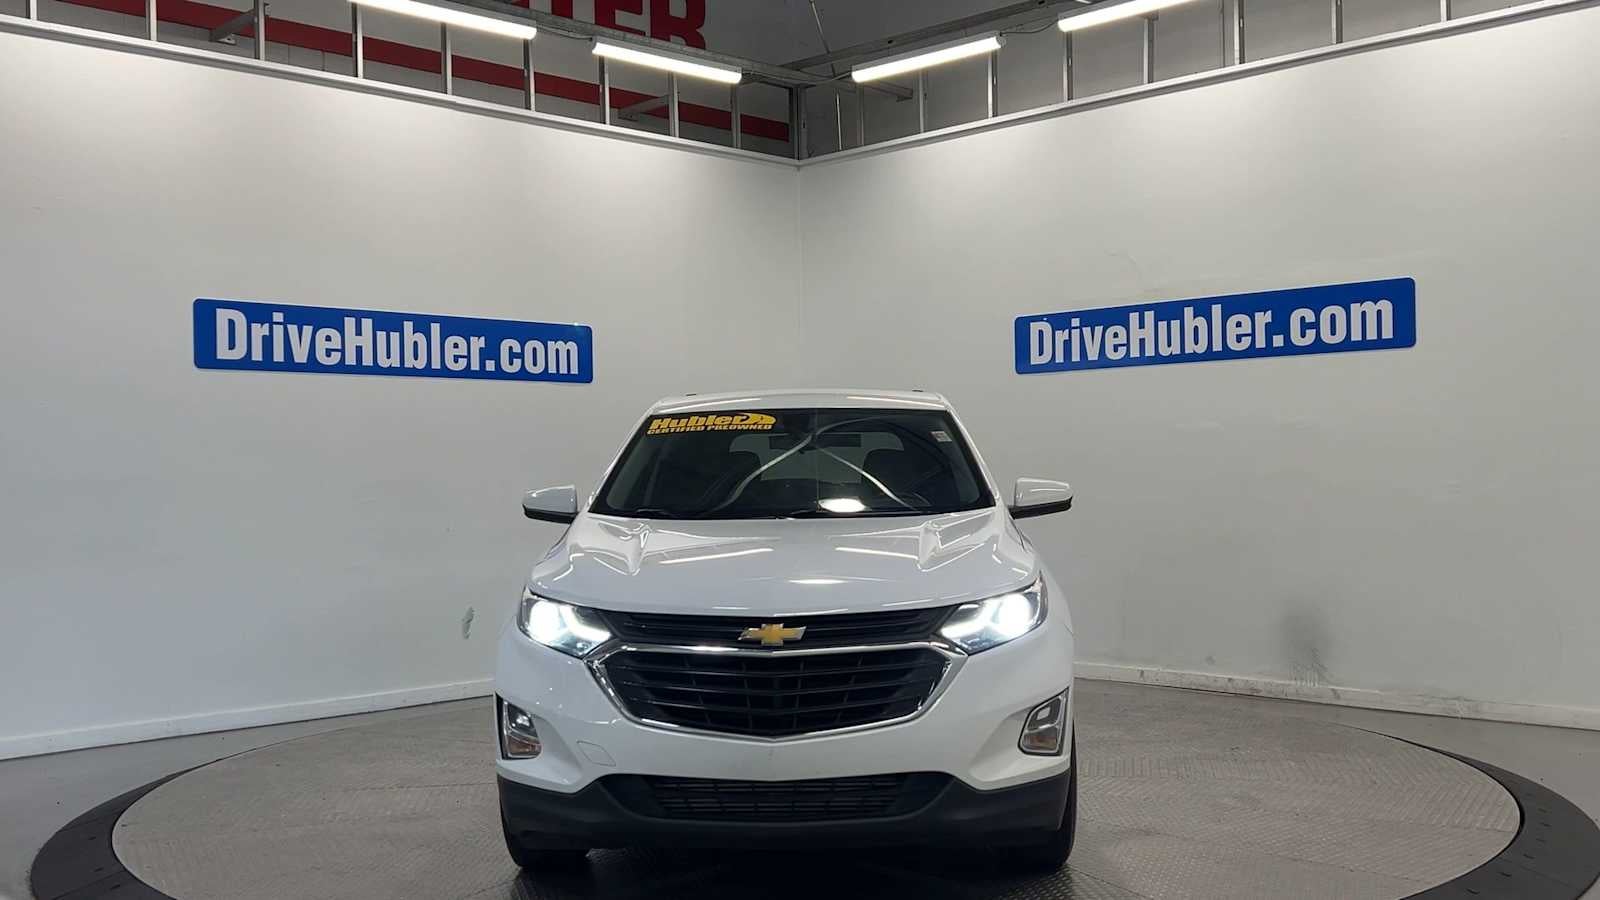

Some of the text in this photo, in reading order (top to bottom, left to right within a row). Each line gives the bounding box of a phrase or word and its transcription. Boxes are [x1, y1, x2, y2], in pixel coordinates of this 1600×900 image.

[216, 308, 579, 375] DriveHubler.com
[1030, 299, 1393, 365] DriveHubler.com
[647, 426, 704, 435] CERTIFIED
[650, 414, 756, 430] Hubler
